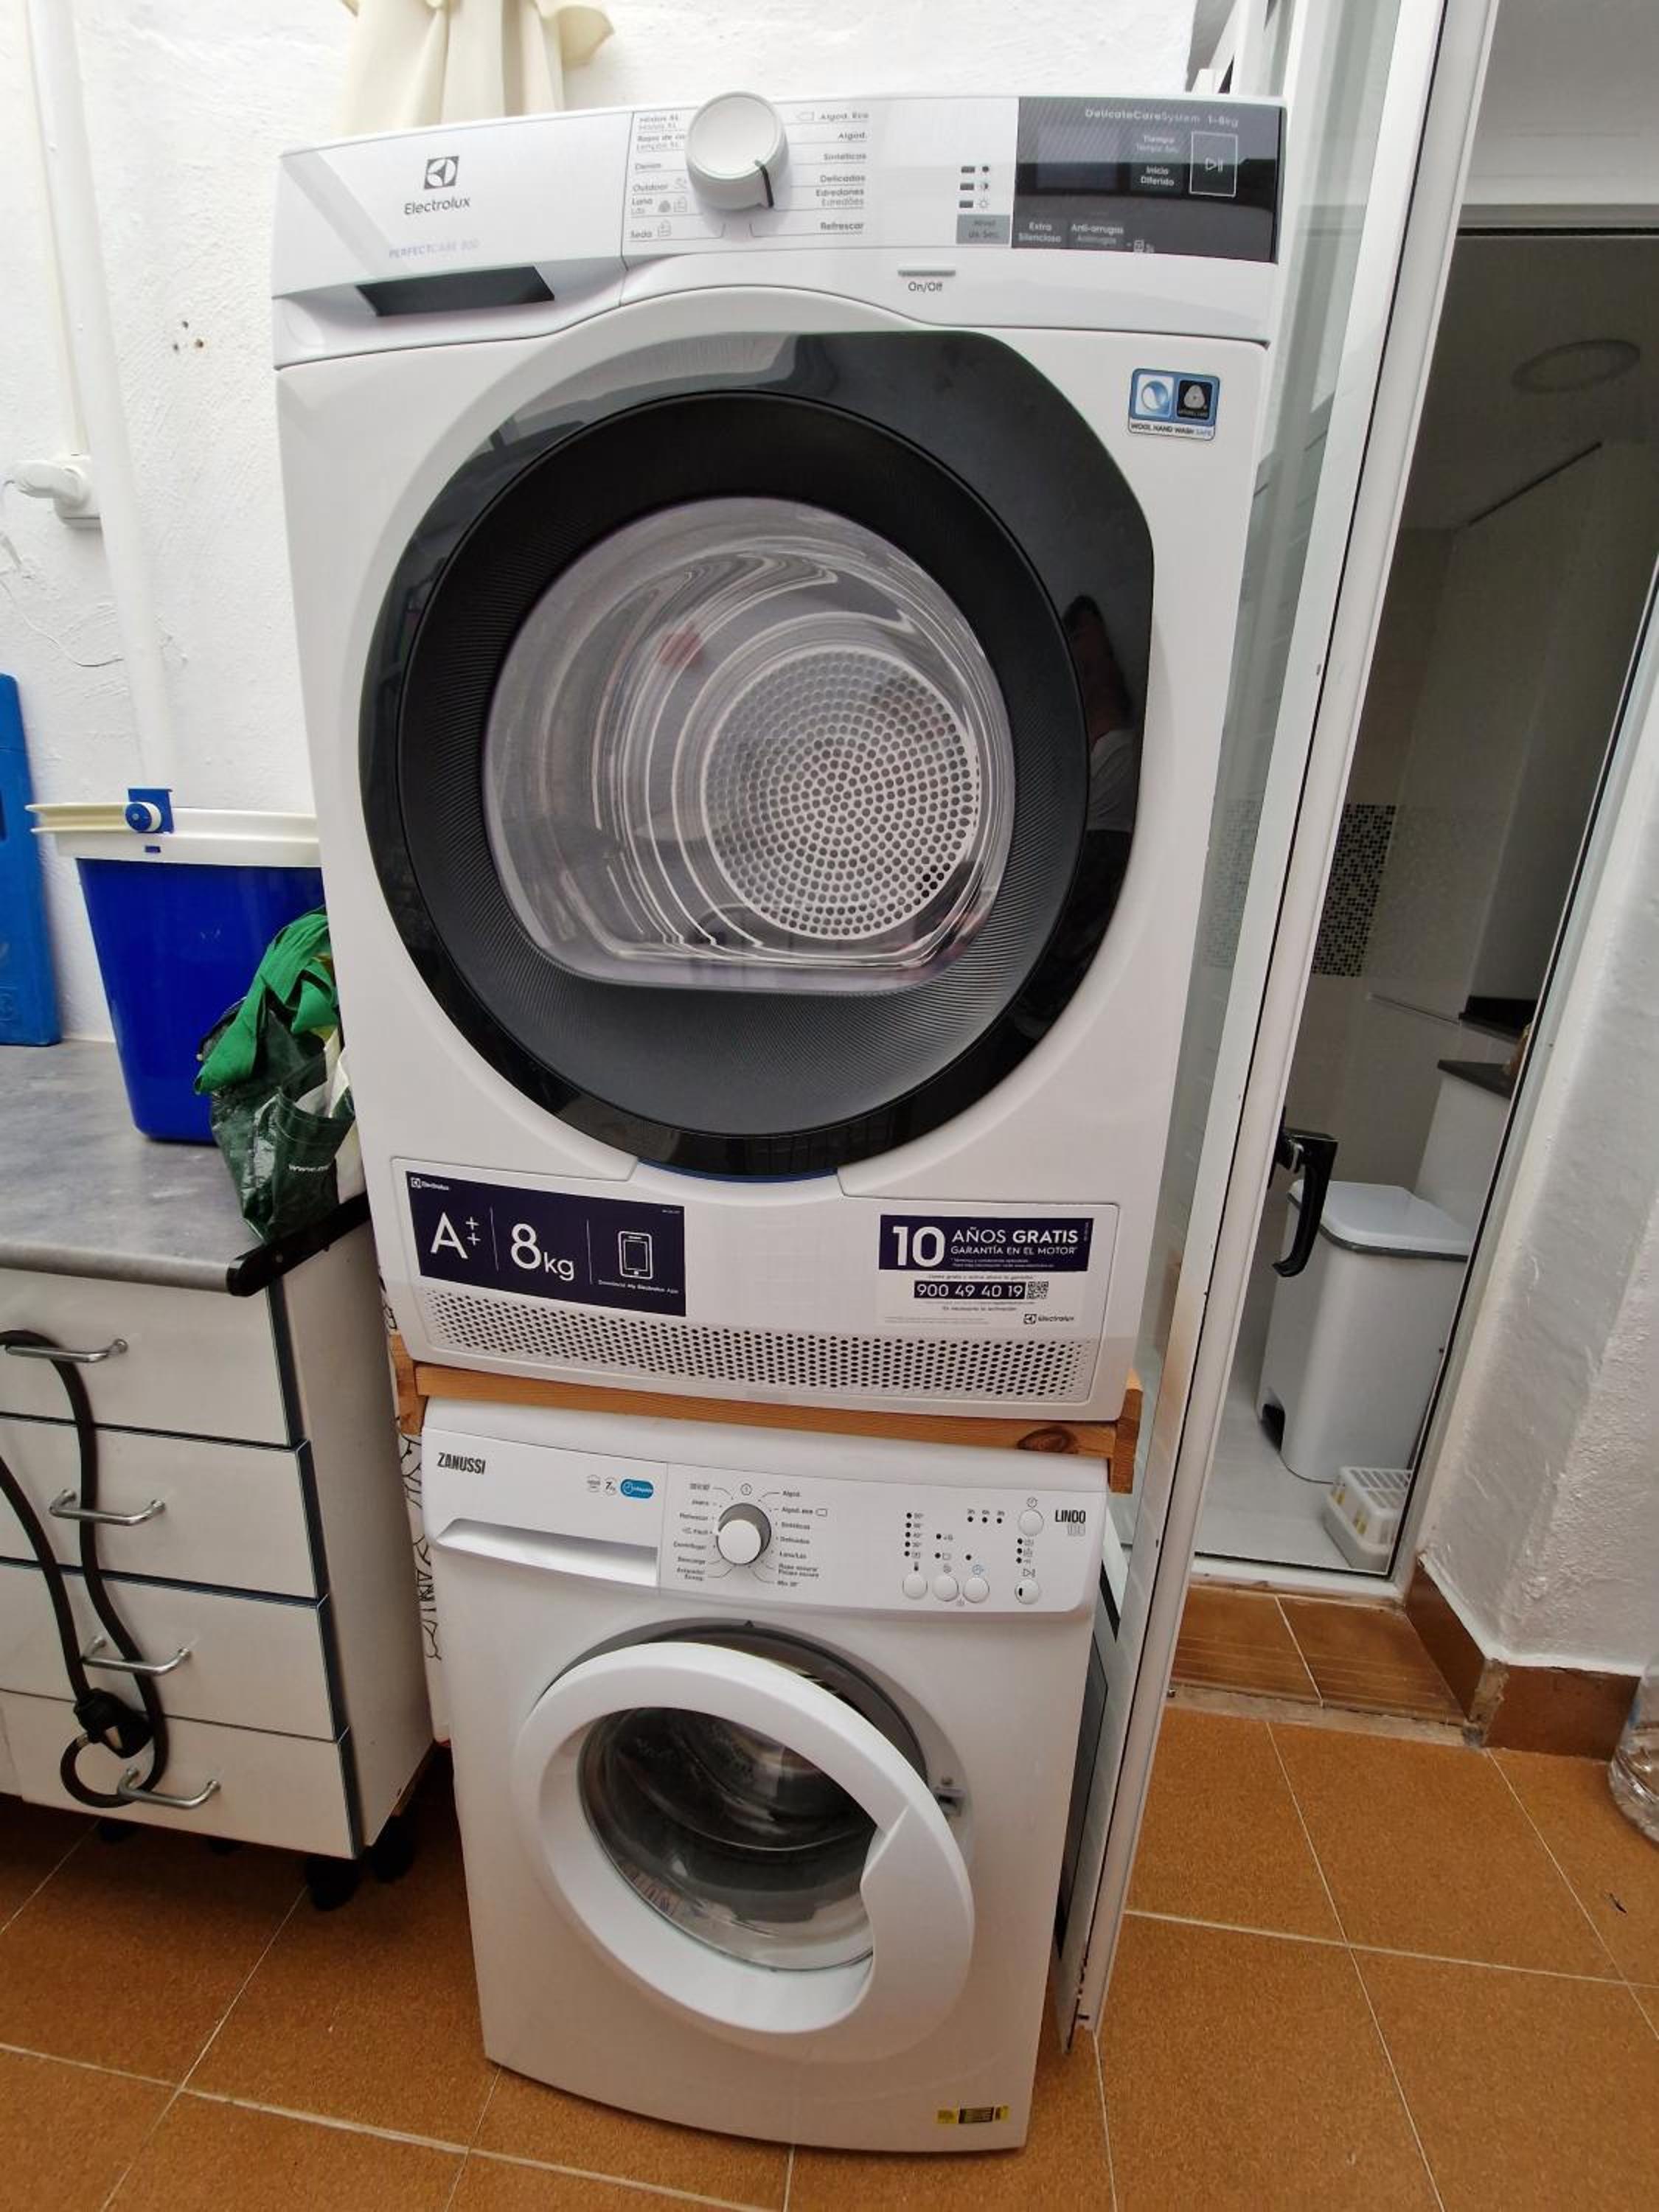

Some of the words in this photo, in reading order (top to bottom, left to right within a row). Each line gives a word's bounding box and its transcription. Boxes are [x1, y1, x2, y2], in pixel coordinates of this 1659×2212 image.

[403, 197, 471, 215] Electrolux
[819, 222, 864, 231] Refrescar
[1029, 222, 1052, 232] Extra
[630, 229, 652, 238] Seda
[908, 281, 943, 293] On/Off
[892, 1225, 946, 1267] 10
[951, 1226, 1006, 1244] AÑOS
[1012, 1229, 1079, 1244] GRATIS
[950, 1244, 1003, 1255] GARANTÍA
[1006, 1245, 1020, 1255] EN
[1023, 1246, 1034, 1256] EL
[917, 1283, 949, 1296] 900
[955, 1283, 975, 1297] 49
[981, 1284, 1002, 1297] 40
[1008, 1285, 1023, 1298] 19
[437, 1452, 486, 1474] ZANUSSI
